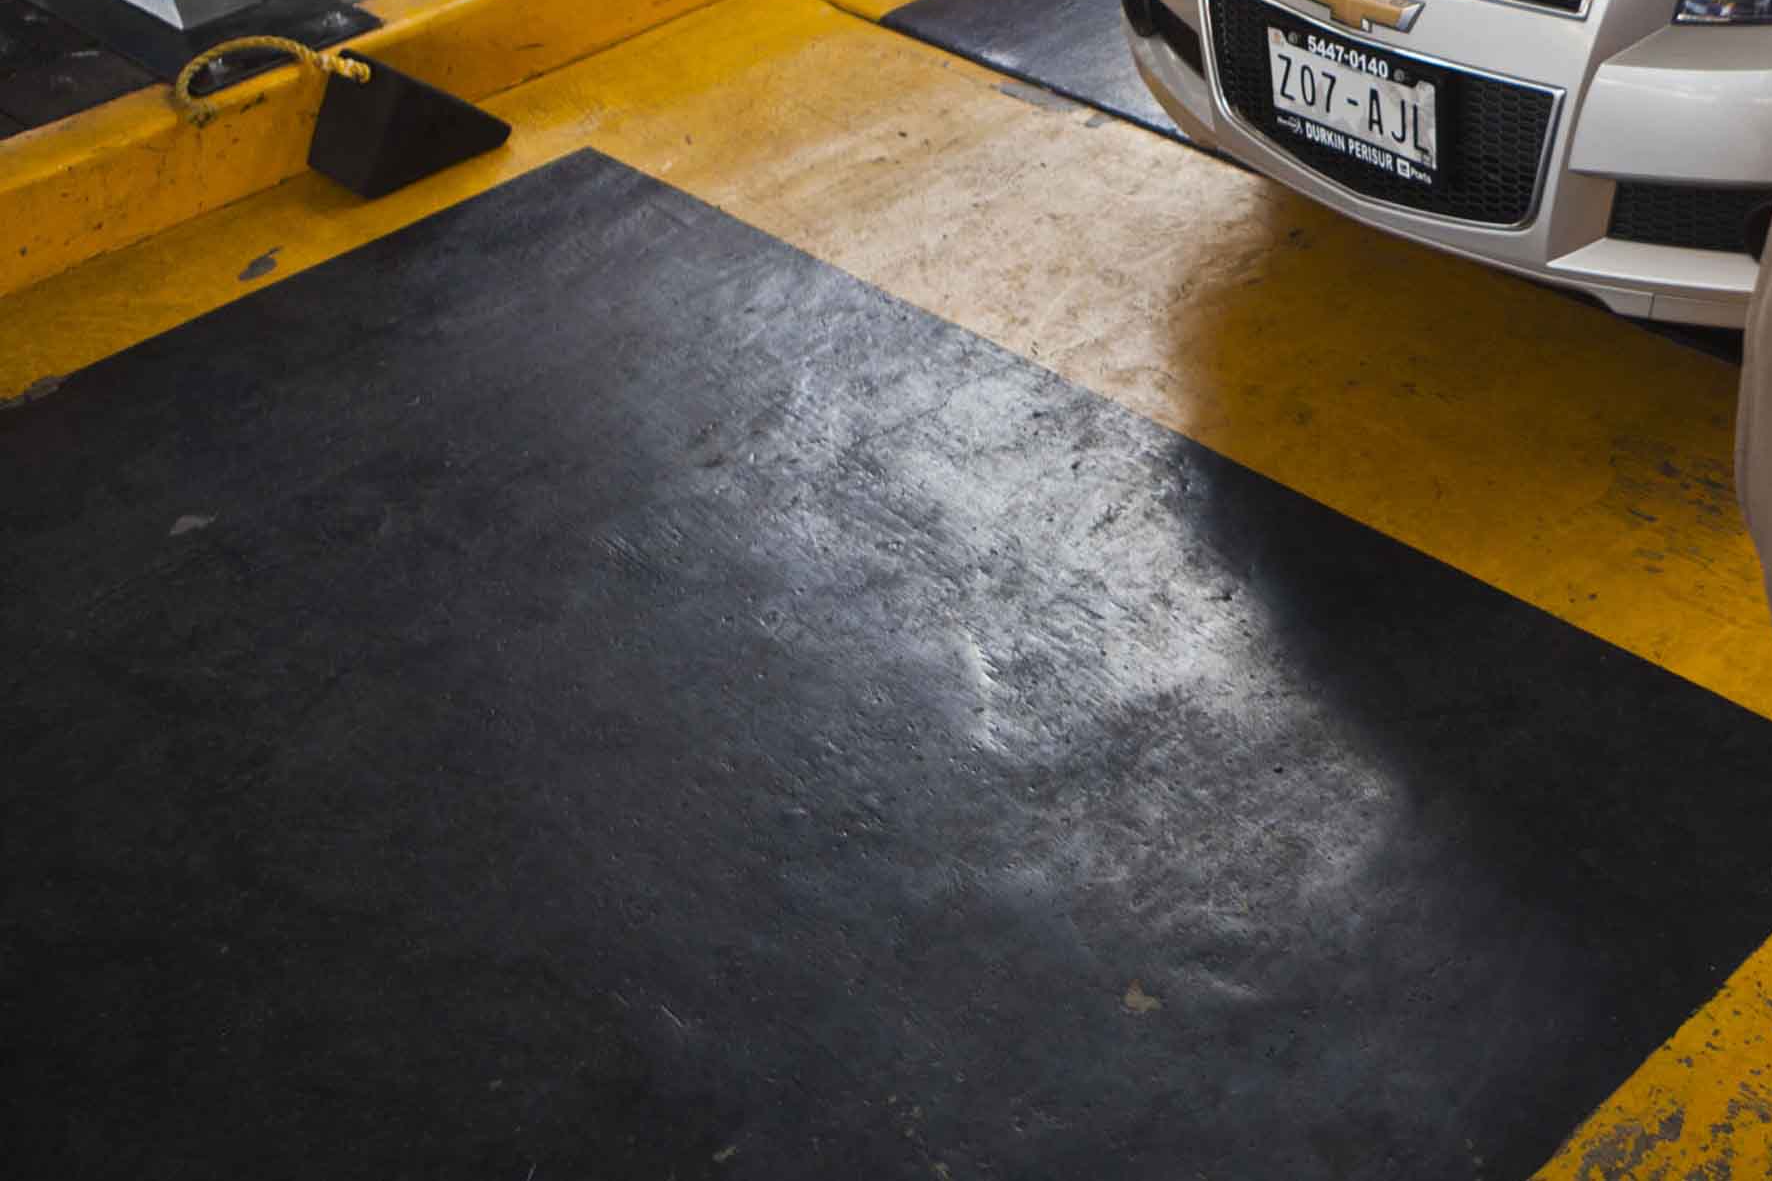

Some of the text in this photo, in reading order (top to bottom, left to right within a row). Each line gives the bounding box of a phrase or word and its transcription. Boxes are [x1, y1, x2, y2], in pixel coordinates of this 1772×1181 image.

[1307, 34, 1389, 79] 5447-0140
[1277, 53, 1431, 157] Z07-AJL
[1305, 122, 1346, 152] DURKIN
[1347, 138, 1395, 172] PERISUR
